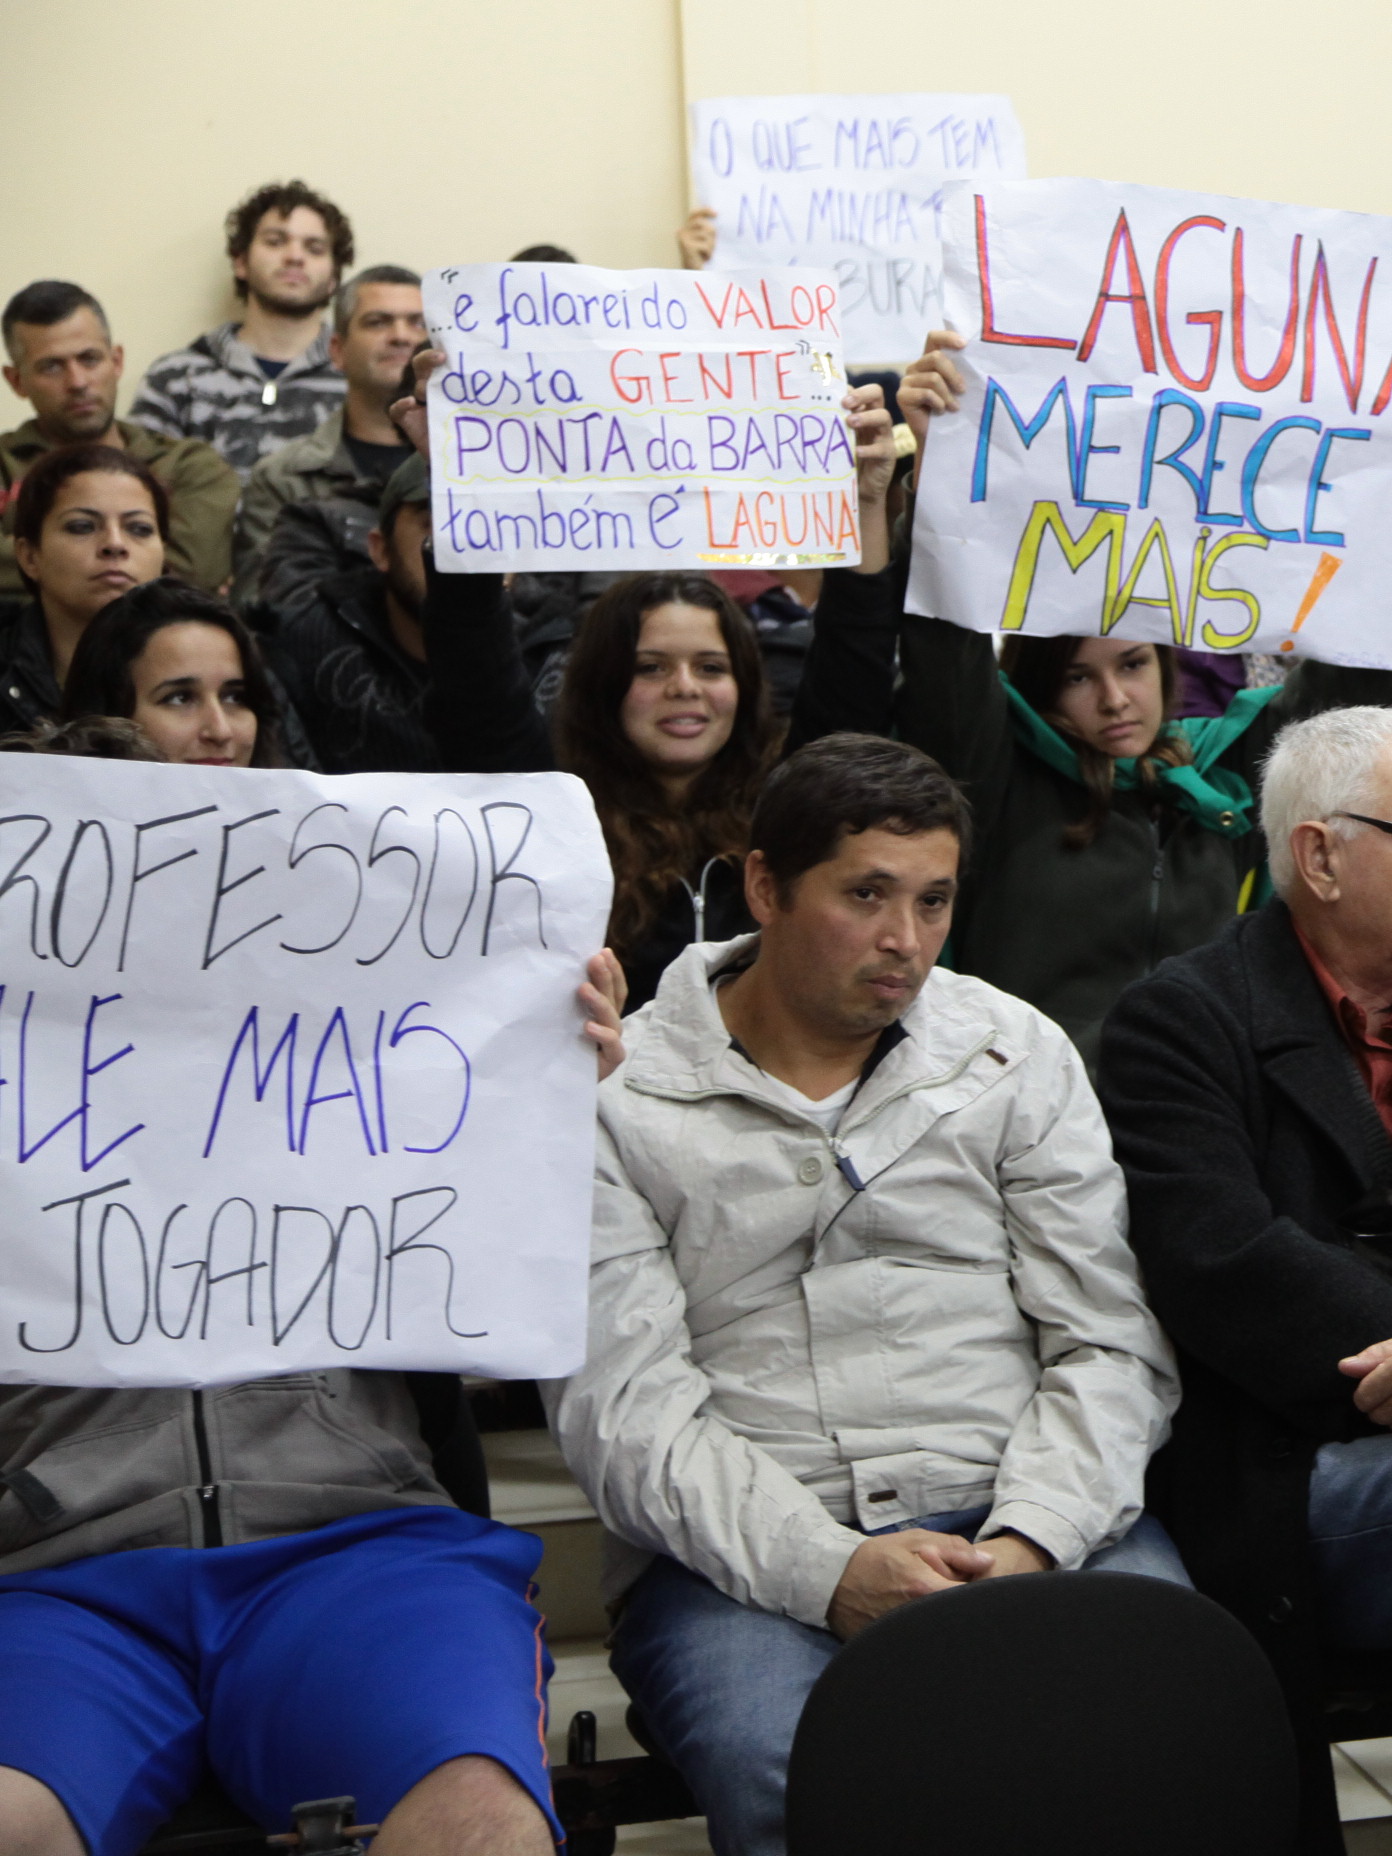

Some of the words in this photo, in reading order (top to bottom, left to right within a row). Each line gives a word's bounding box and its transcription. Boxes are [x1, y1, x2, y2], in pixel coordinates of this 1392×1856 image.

[710, 117, 734, 178] O
[752, 116, 822, 173] QUE
[834, 116, 920, 170] MAIS
[927, 114, 1002, 170] TEM
[737, 184, 797, 245] NA
[806, 188, 919, 245] MINHA
[641, 281, 688, 330] do
[694, 278, 841, 338] VALOR
[441, 351, 583, 406] desta
[454, 412, 636, 477] PONTA
[646, 416, 699, 472] da
[706, 413, 857, 475] BARRA
[970, 375, 1372, 548] MERECE
[440, 486, 636, 553] também
[0, 985, 147, 1172] LE
[203, 1002, 472, 1159] MAIS
[19, 1178, 489, 1354] JOGADOR
